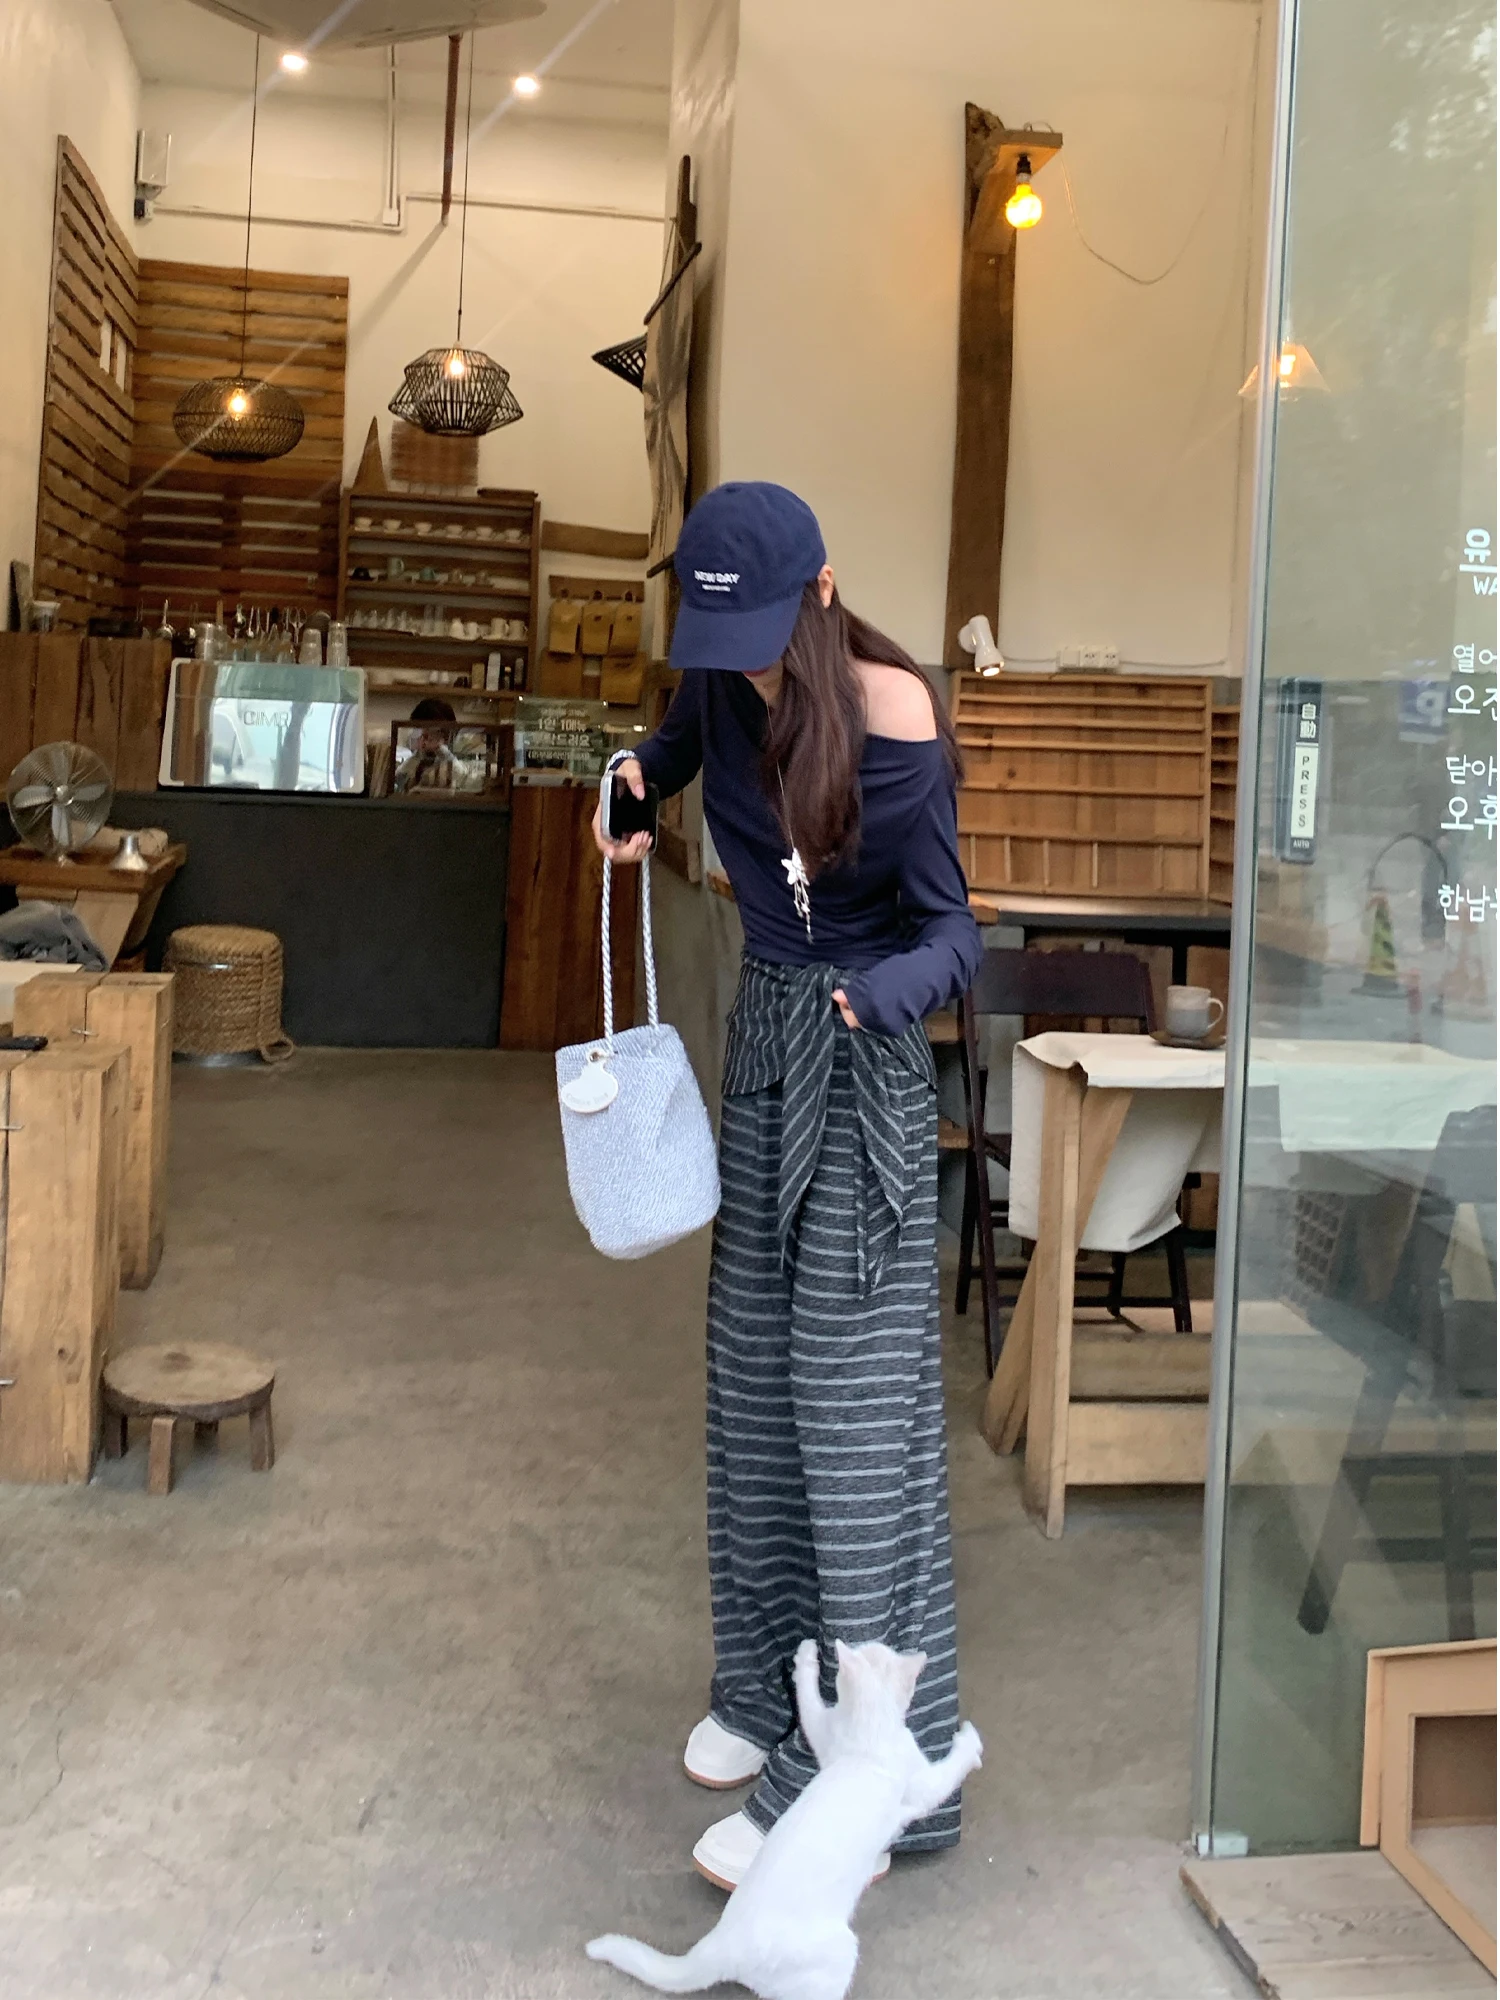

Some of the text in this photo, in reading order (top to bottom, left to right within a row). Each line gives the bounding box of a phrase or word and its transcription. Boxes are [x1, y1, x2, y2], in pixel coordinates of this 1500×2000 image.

[1464, 528, 1491, 564] 유
[716, 572, 740, 584] DAY
[1300, 702, 1317, 739] 自動
[1298, 755, 1310, 828] PRESS
[1292, 839, 1311, 850] AUTO
[1437, 883, 1497, 922] 한남
